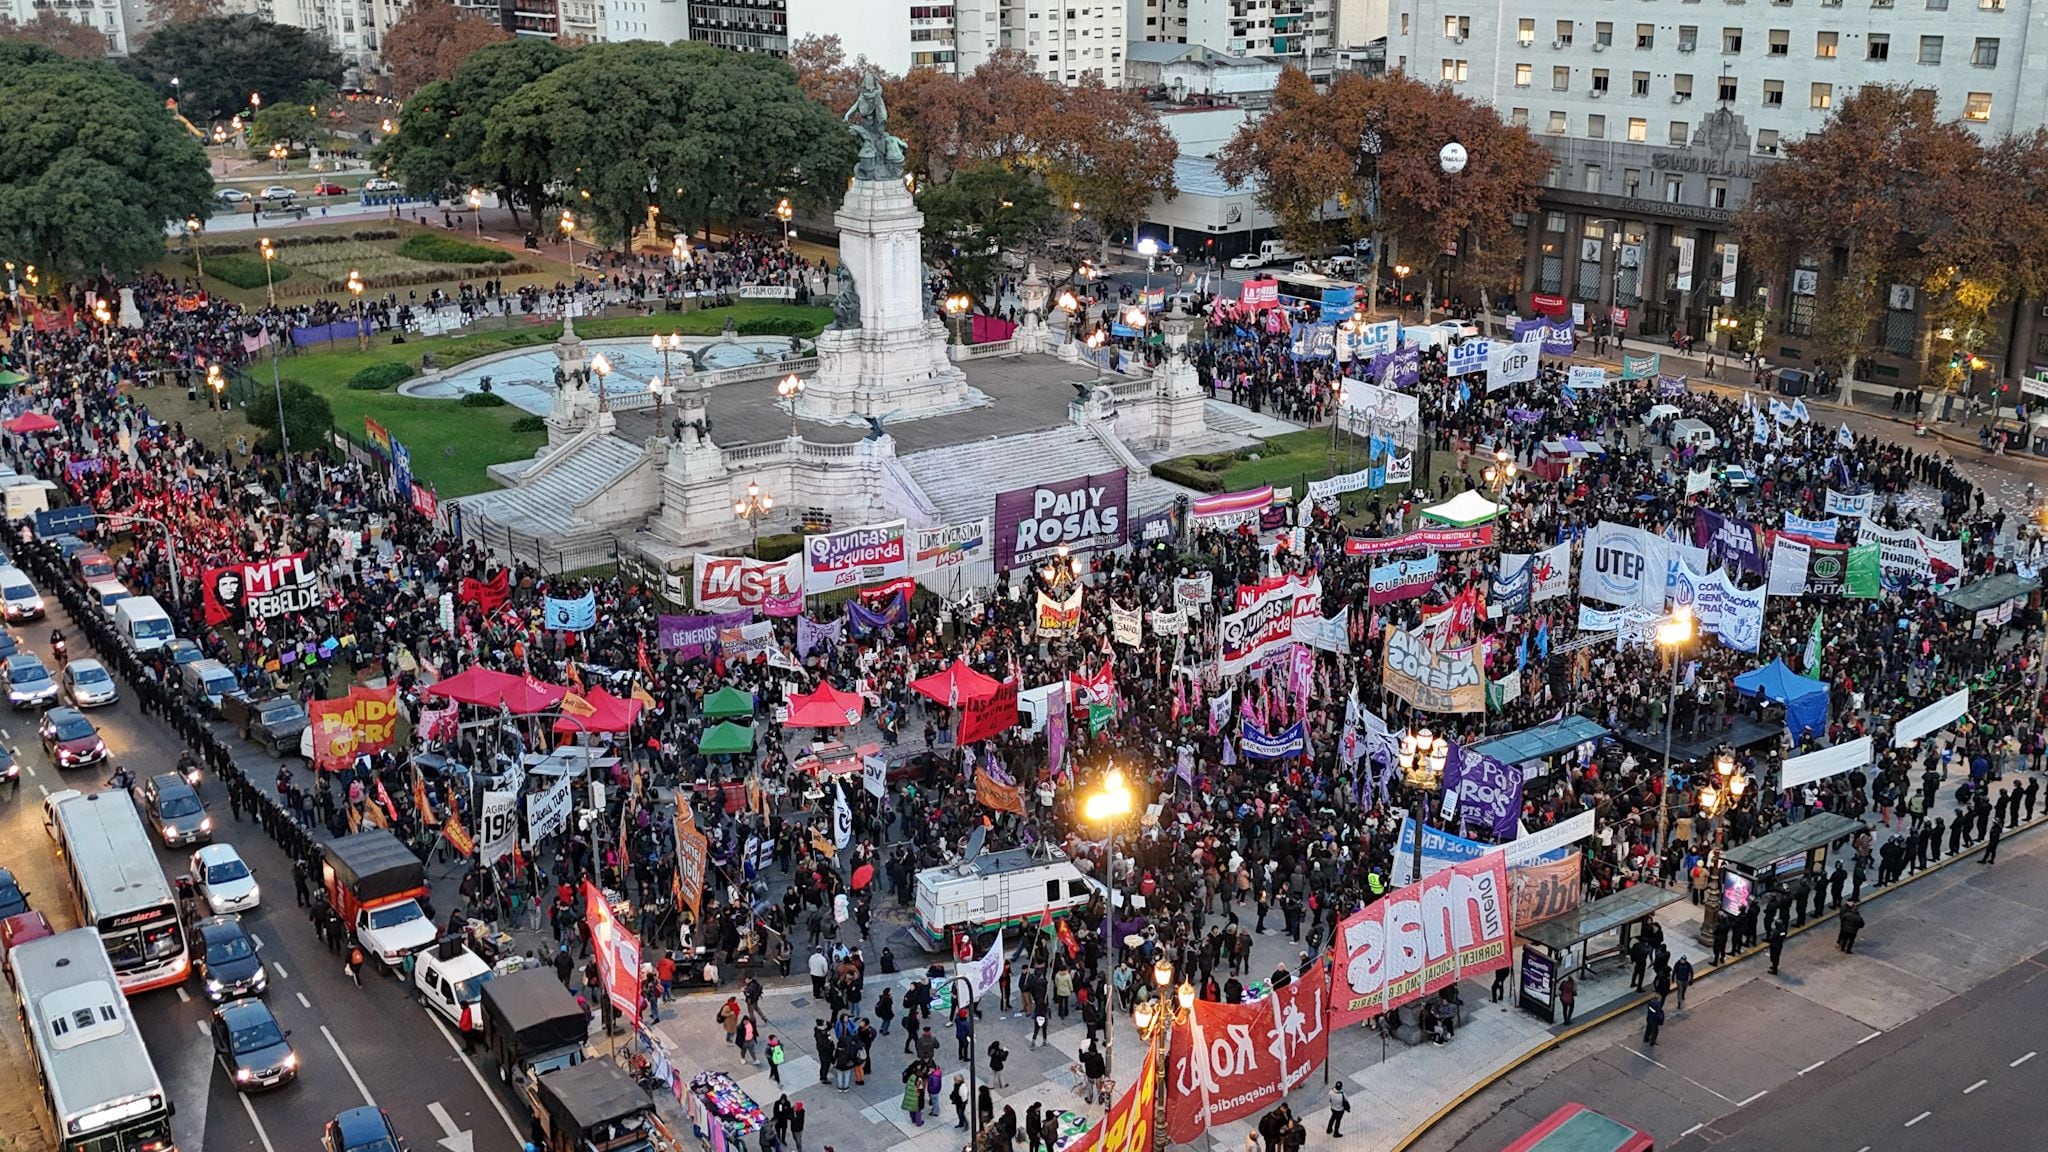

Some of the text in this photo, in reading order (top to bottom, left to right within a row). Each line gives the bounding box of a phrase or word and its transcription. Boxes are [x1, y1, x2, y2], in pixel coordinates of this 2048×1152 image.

[1652, 153, 1699, 172] SENADO
[1650, 203, 1693, 216] SENADOR
[1454, 342, 1489, 360] CCC
[1503, 355, 1528, 373] UTEP
[1088, 486, 1106, 507] Y
[1015, 506, 1119, 552] ROSAS
[829, 543, 900, 570] izquierda
[1596, 547, 1645, 581] UTEP
[244, 557, 316, 592] MTL
[704, 561, 788, 605] MST
[835, 569, 856, 585] MST
[1791, 583, 1856, 595] CAPITAL
[247, 585, 321, 618] REBELDE
[672, 624, 718, 648] GÉNEROS
